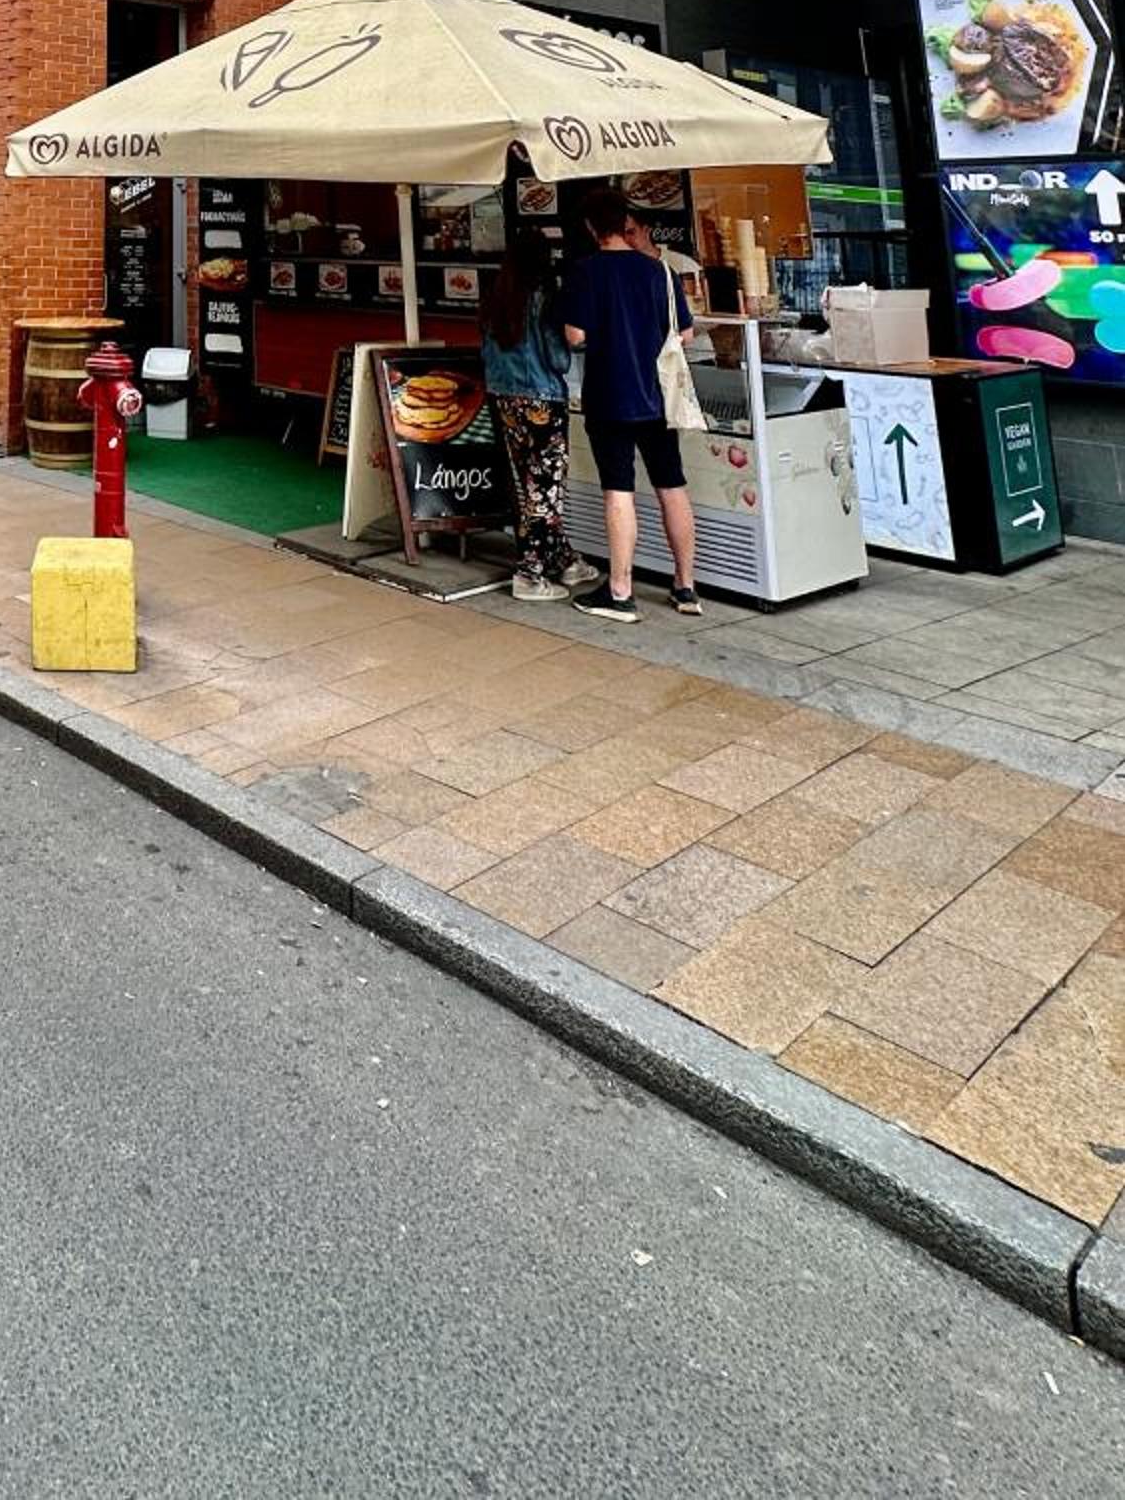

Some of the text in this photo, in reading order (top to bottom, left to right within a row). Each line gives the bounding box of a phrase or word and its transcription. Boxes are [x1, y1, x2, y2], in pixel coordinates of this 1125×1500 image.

[76, 133, 162, 159] ALGIDA
[598, 119, 676, 150] ALGIDA
[1005, 423, 1031, 440] VEGAN
[415, 461, 492, 501] Lángos
